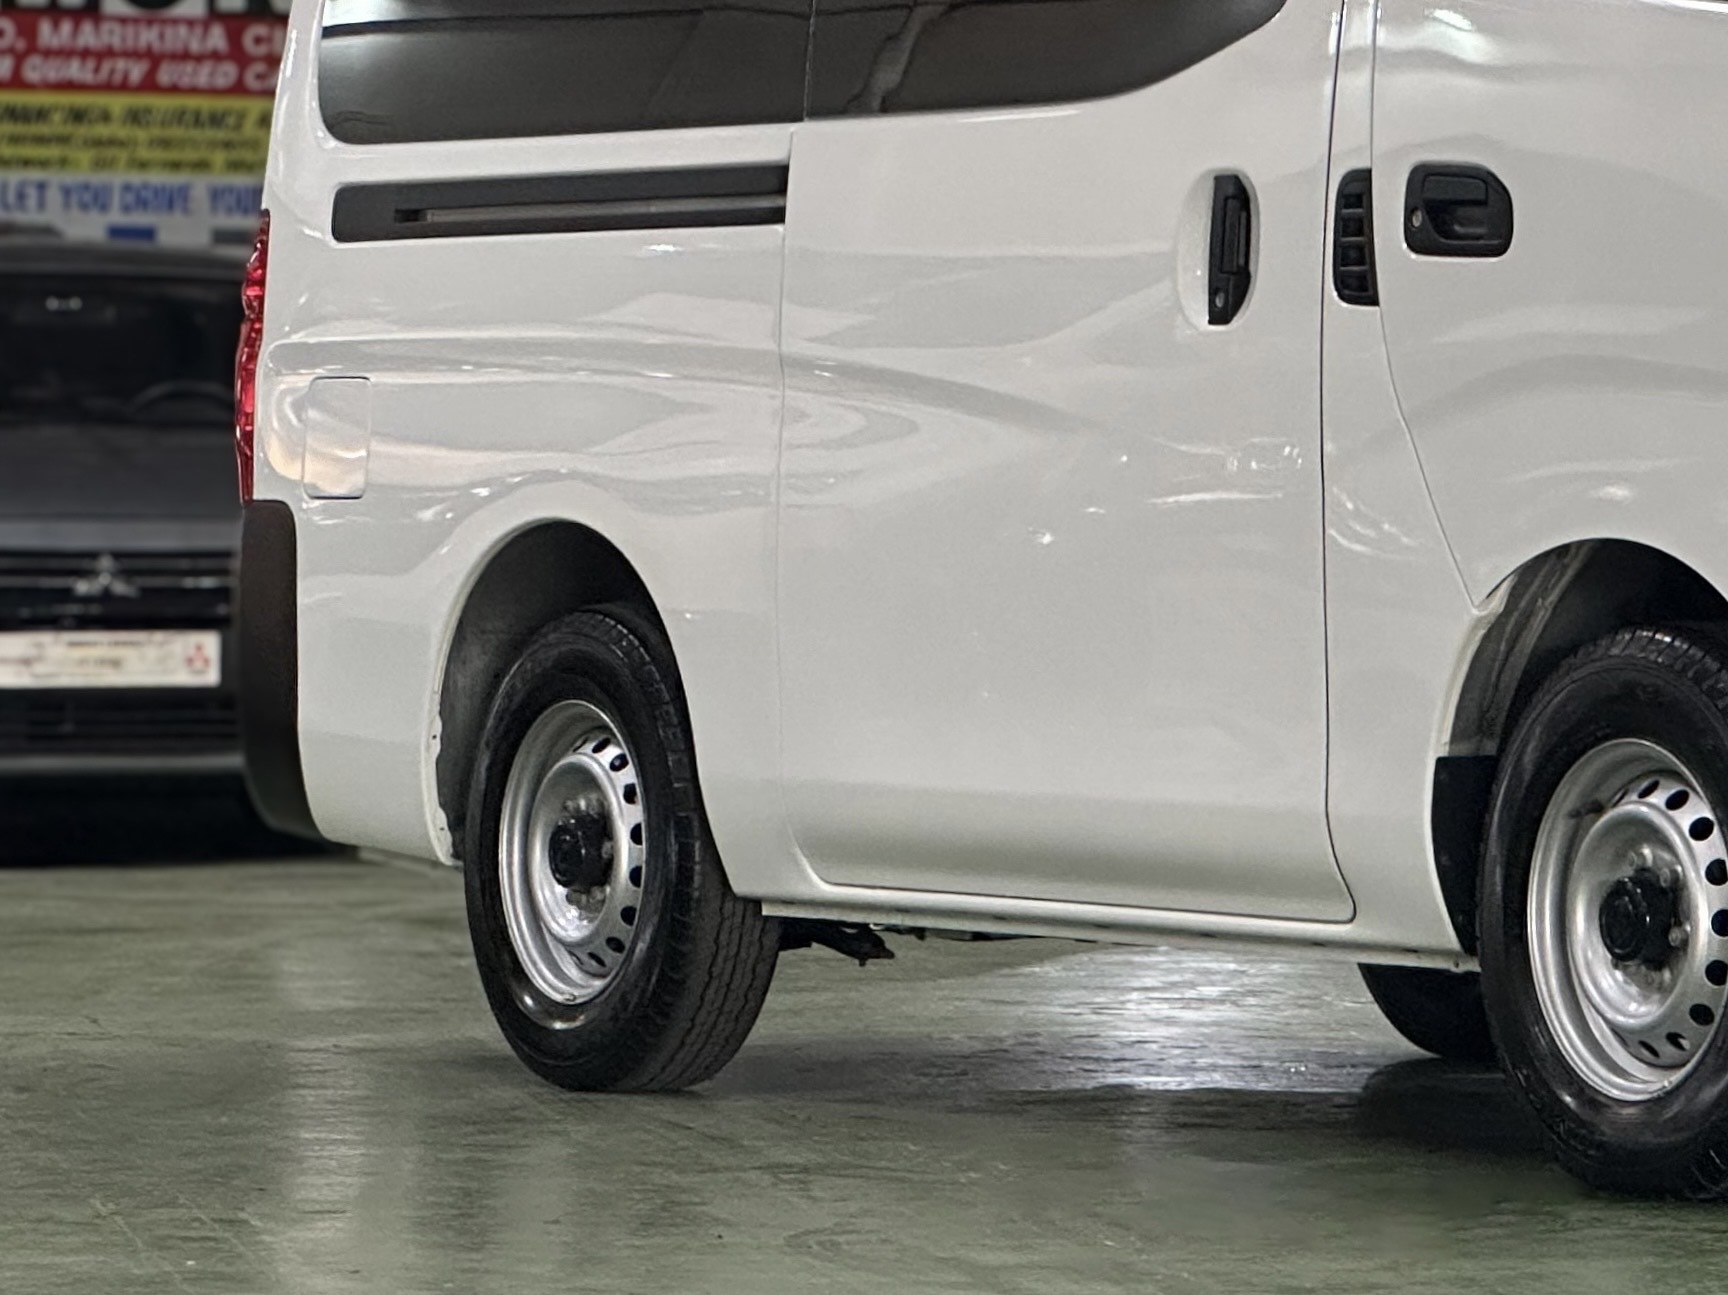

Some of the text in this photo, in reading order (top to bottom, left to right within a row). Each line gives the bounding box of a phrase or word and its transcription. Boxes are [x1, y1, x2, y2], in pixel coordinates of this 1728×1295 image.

[37, 17, 230, 54] MARIKINA
[21, 54, 150, 87] QUALITY
[156, 58, 240, 90] USED
